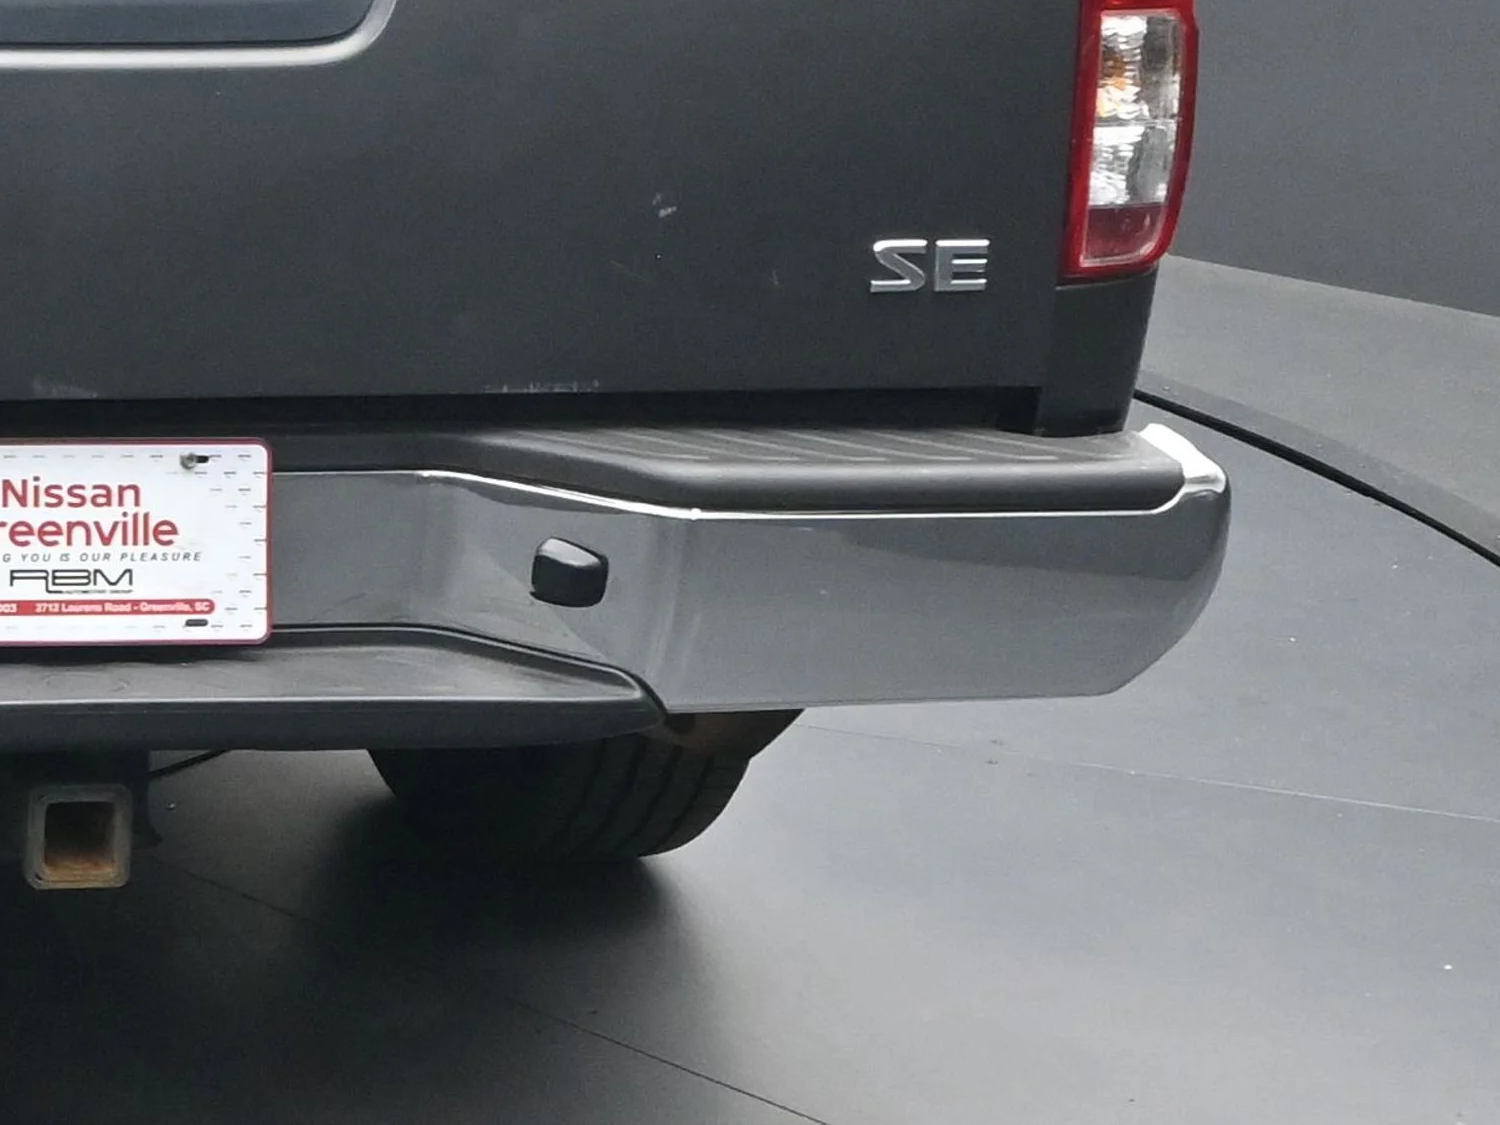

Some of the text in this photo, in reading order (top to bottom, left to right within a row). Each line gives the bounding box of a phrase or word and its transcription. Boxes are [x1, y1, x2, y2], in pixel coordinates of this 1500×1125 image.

[869, 238, 991, 293] SE
[0, 476, 140, 508] Nissan
[20, 552, 52, 563] YOU
[59, 552, 71, 562] IS
[79, 552, 112, 563] OUR
[119, 551, 203, 563] PLEASURE
[9, 568, 133, 594] RBM
[104, 602, 133, 612] Road
